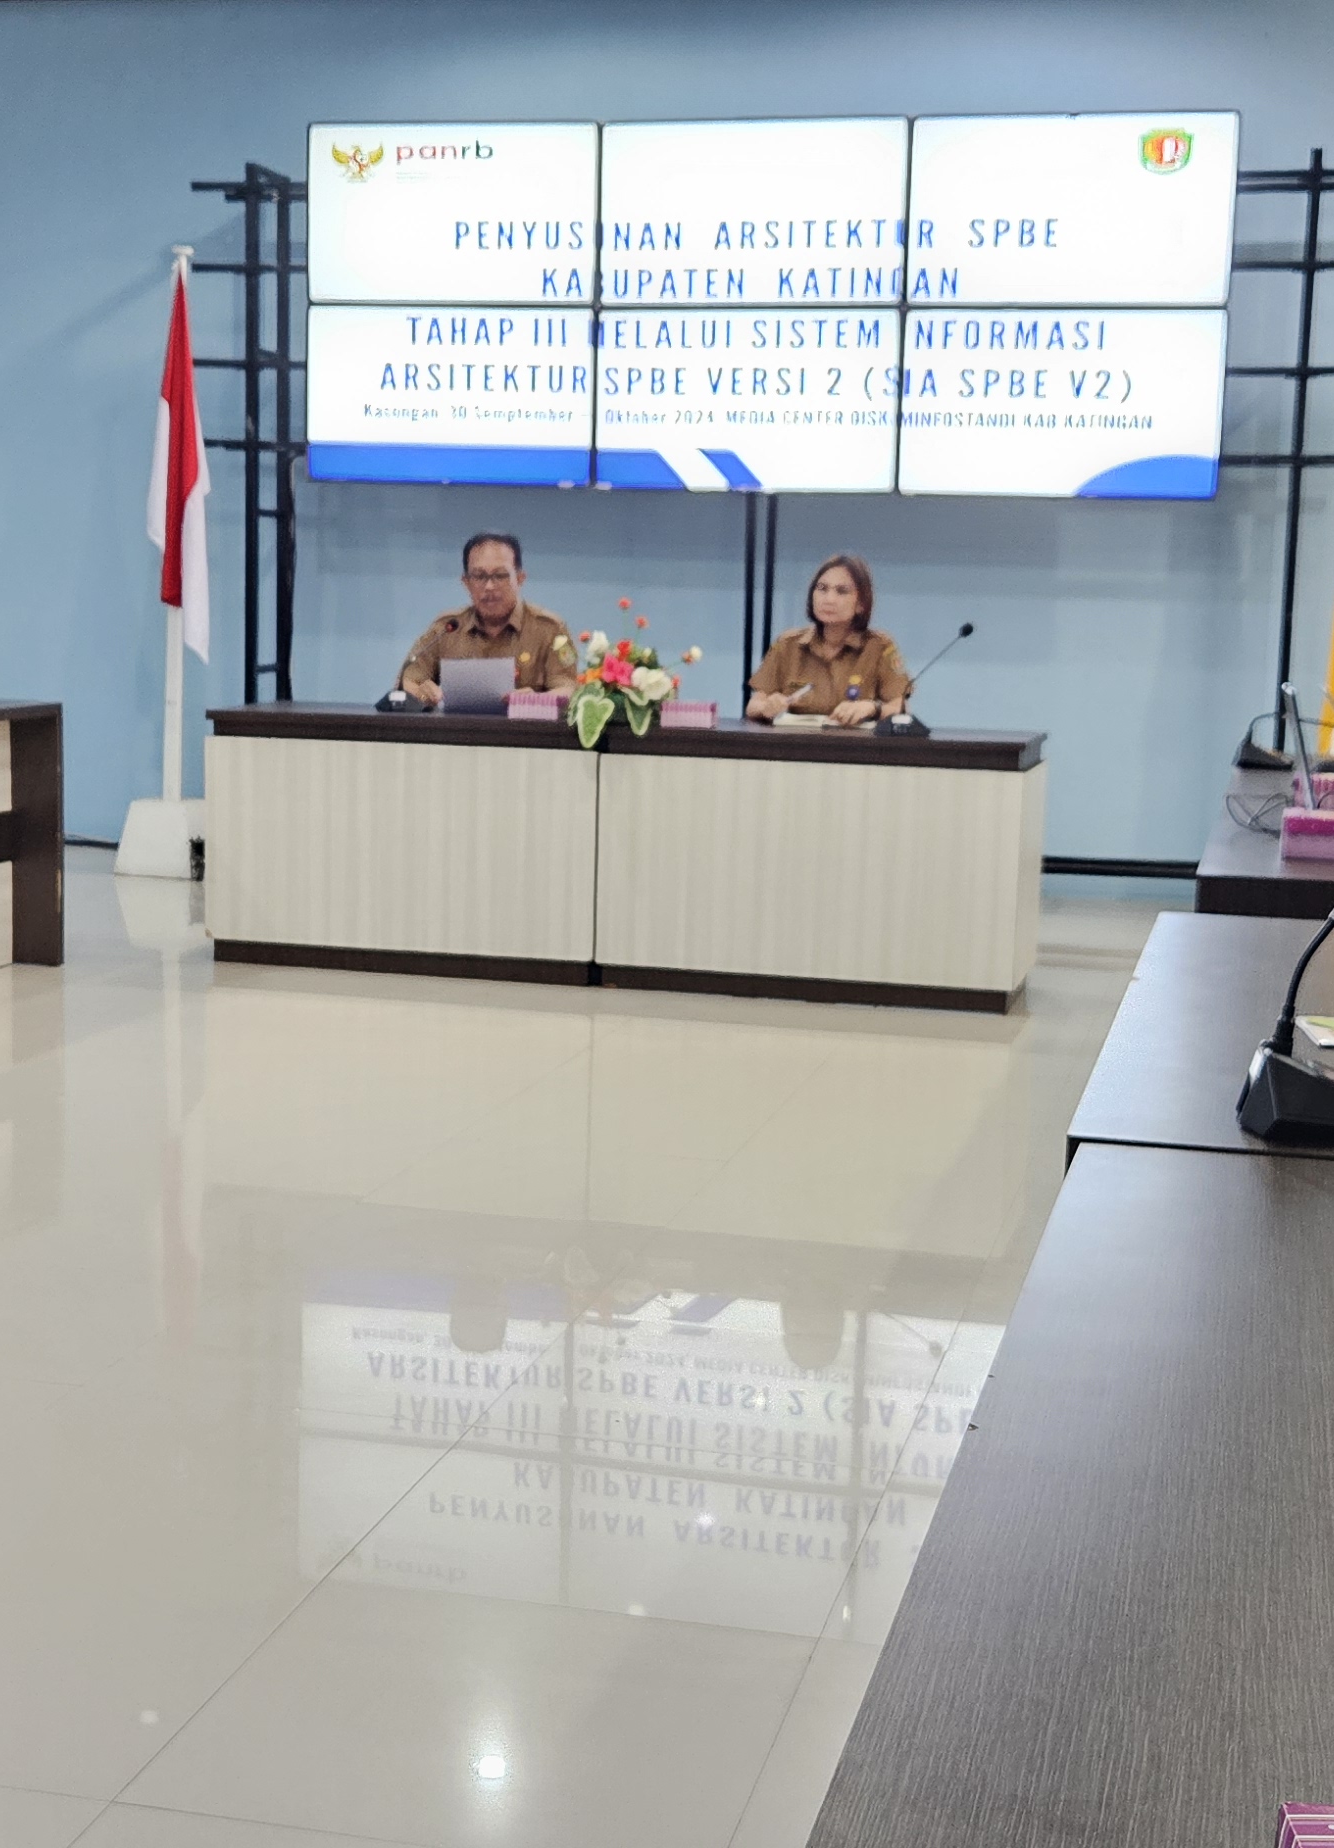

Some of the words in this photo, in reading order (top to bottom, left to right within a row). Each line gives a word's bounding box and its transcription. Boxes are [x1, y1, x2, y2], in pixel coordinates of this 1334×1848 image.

[396, 139, 494, 165] panrb
[455, 221, 682, 251] PENYUSNAN
[968, 218, 1059, 249] SPBE
[542, 267, 745, 299] KAUPATEN
[406, 315, 514, 346] TAHAP
[533, 318, 567, 348] III
[751, 318, 881, 349] SISTEM
[901, 319, 1107, 351] NFORMASI
[380, 362, 587, 394] ARSITEKTUR
[604, 366, 687, 396] SPBE
[706, 367, 806, 397] VERSI
[826, 367, 842, 397] 2
[863, 366, 938, 402] (SIA
[958, 368, 1048, 399] SPBE
[1069, 368, 1133, 404] V2)
[725, 409, 776, 426] MEDIA
[782, 410, 844, 426] CENTER
[850, 410, 1016, 429] DISKMINFOSTANDI
